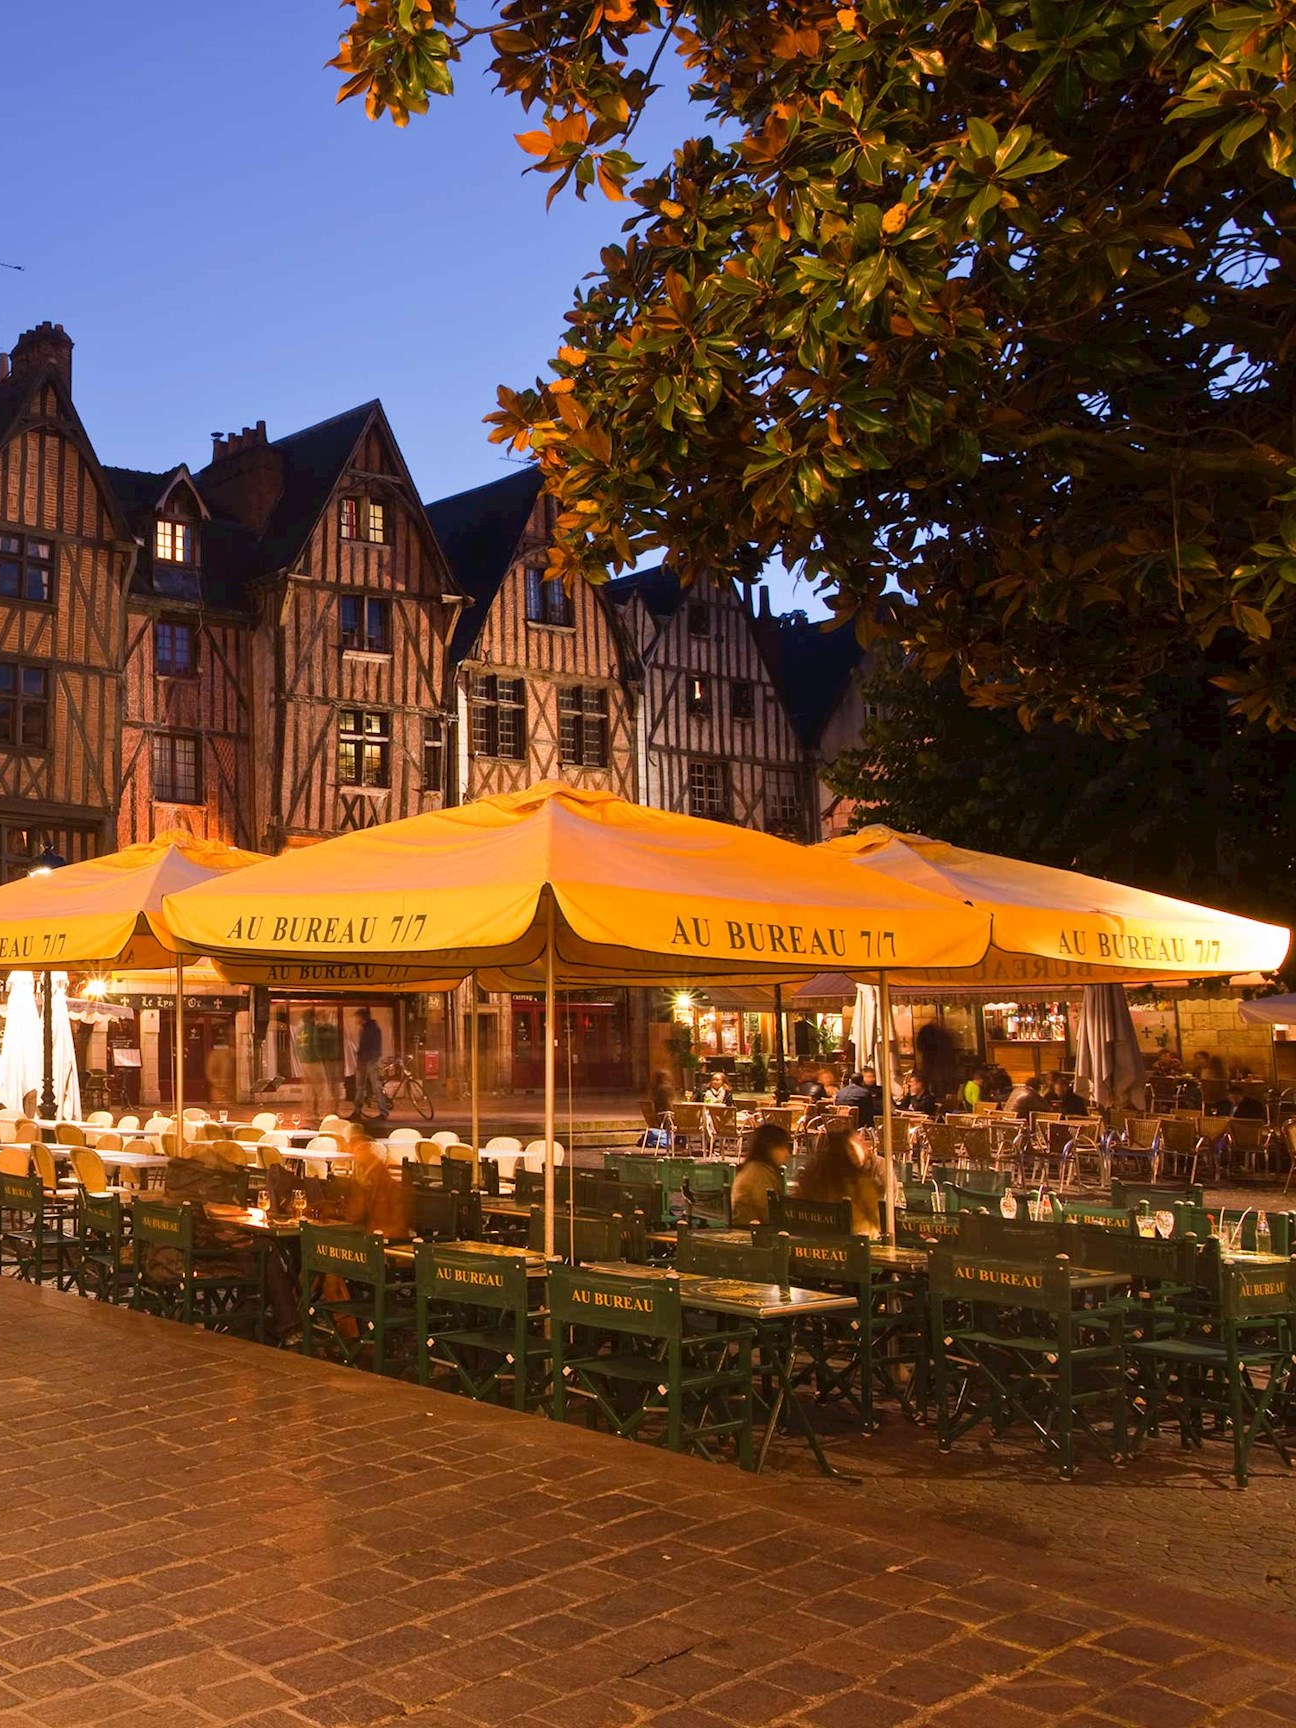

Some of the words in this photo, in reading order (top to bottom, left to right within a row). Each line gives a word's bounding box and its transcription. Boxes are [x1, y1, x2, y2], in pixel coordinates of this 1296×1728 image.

[227, 915, 264, 941] AU
[272, 916, 379, 944] BUREAU
[390, 914, 427, 944] 7/7
[671, 915, 711, 947] AU
[725, 921, 847, 957] BUREAU
[860, 931, 896, 958] 7/7
[43, 934, 67, 956] 7/7
[1059, 929, 1086, 956] AU
[1097, 932, 1185, 962] BUREAU
[1195, 939, 1220, 964] 7/7
[267, 966, 290, 981] AU
[300, 965, 376, 980] BUREAU
[141, 996, 153, 1007] Le
[157, 996, 174, 1008] Lys
[183, 997, 202, 1008] 'Or
[142, 1217, 152, 1227] AU
[152, 1218, 180, 1233] BUREAU
[784, 1209, 796, 1221] AU
[798, 1211, 836, 1225] BUREAU
[1084, 1214, 1130, 1229] BUREAU
[919, 1223, 959, 1236] BUREA
[316, 1243, 328, 1256] AU
[329, 1246, 368, 1264] BUREAU
[795, 1247, 848, 1262] BUREAU
[436, 1267, 452, 1280] AU
[454, 1270, 504, 1287] BUREAU
[955, 1267, 975, 1280] AU
[979, 1269, 1043, 1289] BUREAU
[1239, 1284, 1253, 1297] AU
[1254, 1281, 1285, 1296] BUREAU
[572, 1289, 591, 1303] AU
[594, 1292, 654, 1313] BUREAU
